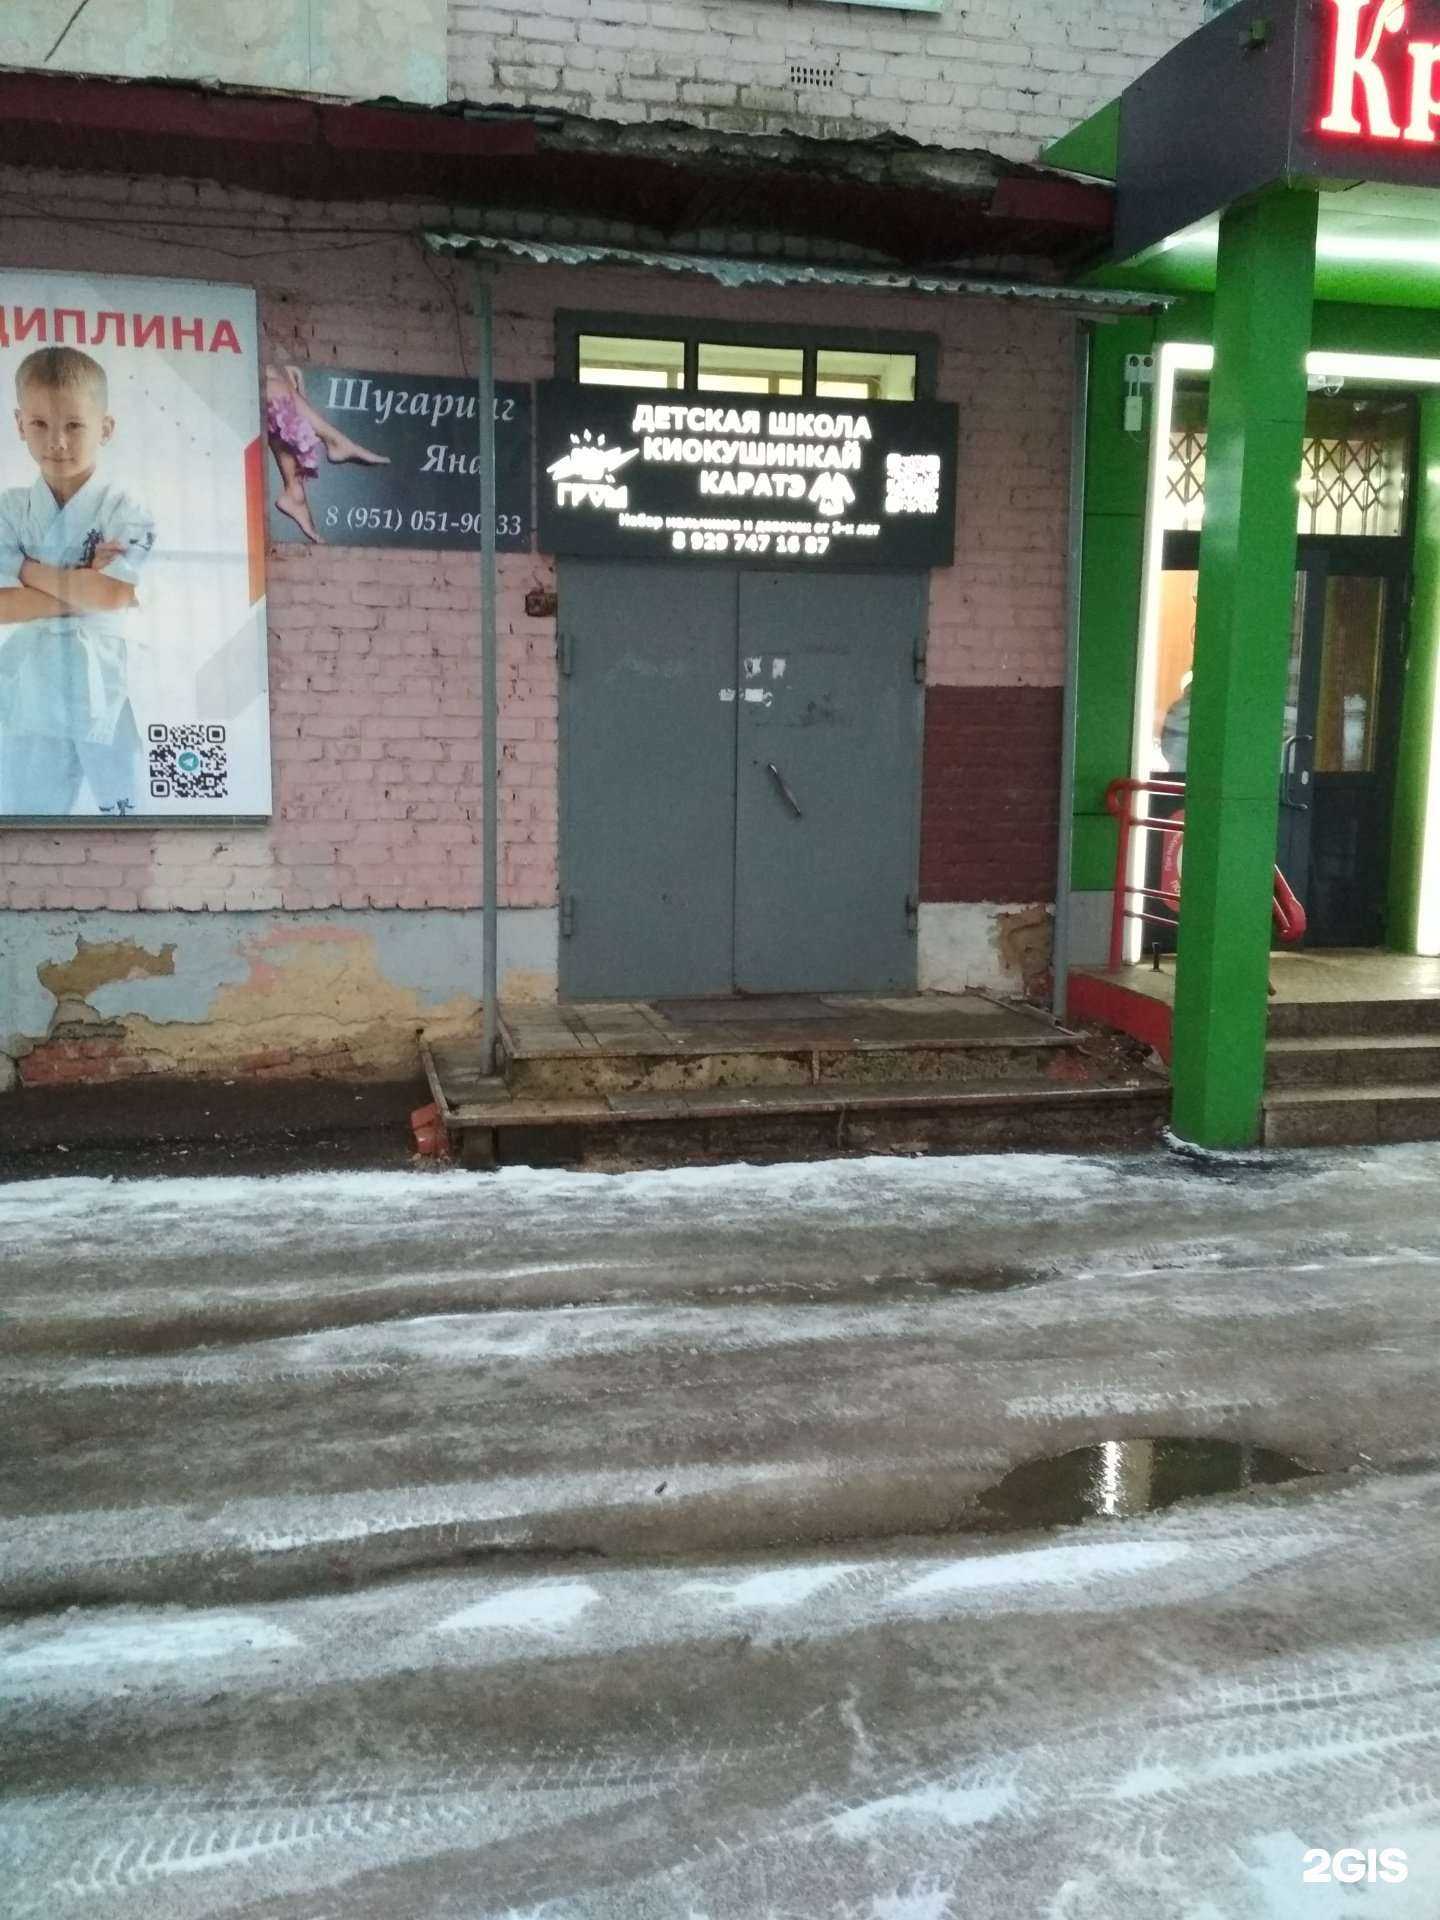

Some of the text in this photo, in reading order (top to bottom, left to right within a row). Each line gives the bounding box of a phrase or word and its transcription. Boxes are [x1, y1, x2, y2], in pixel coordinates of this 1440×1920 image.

[326, 377, 516, 427] Шугариг
[632, 404, 872, 440] ДЕТСКАЯ ШКОЛА
[643, 436, 861, 470] КИОКУШИНКАЙ
[700, 470, 806, 498] КАРАТЭ
[326, 506, 338, 526] 8
[346, 507, 403, 531] (951)
[672, 531, 686, 550] 8
[690, 531, 728, 551] 929
[733, 533, 770, 552] 747
